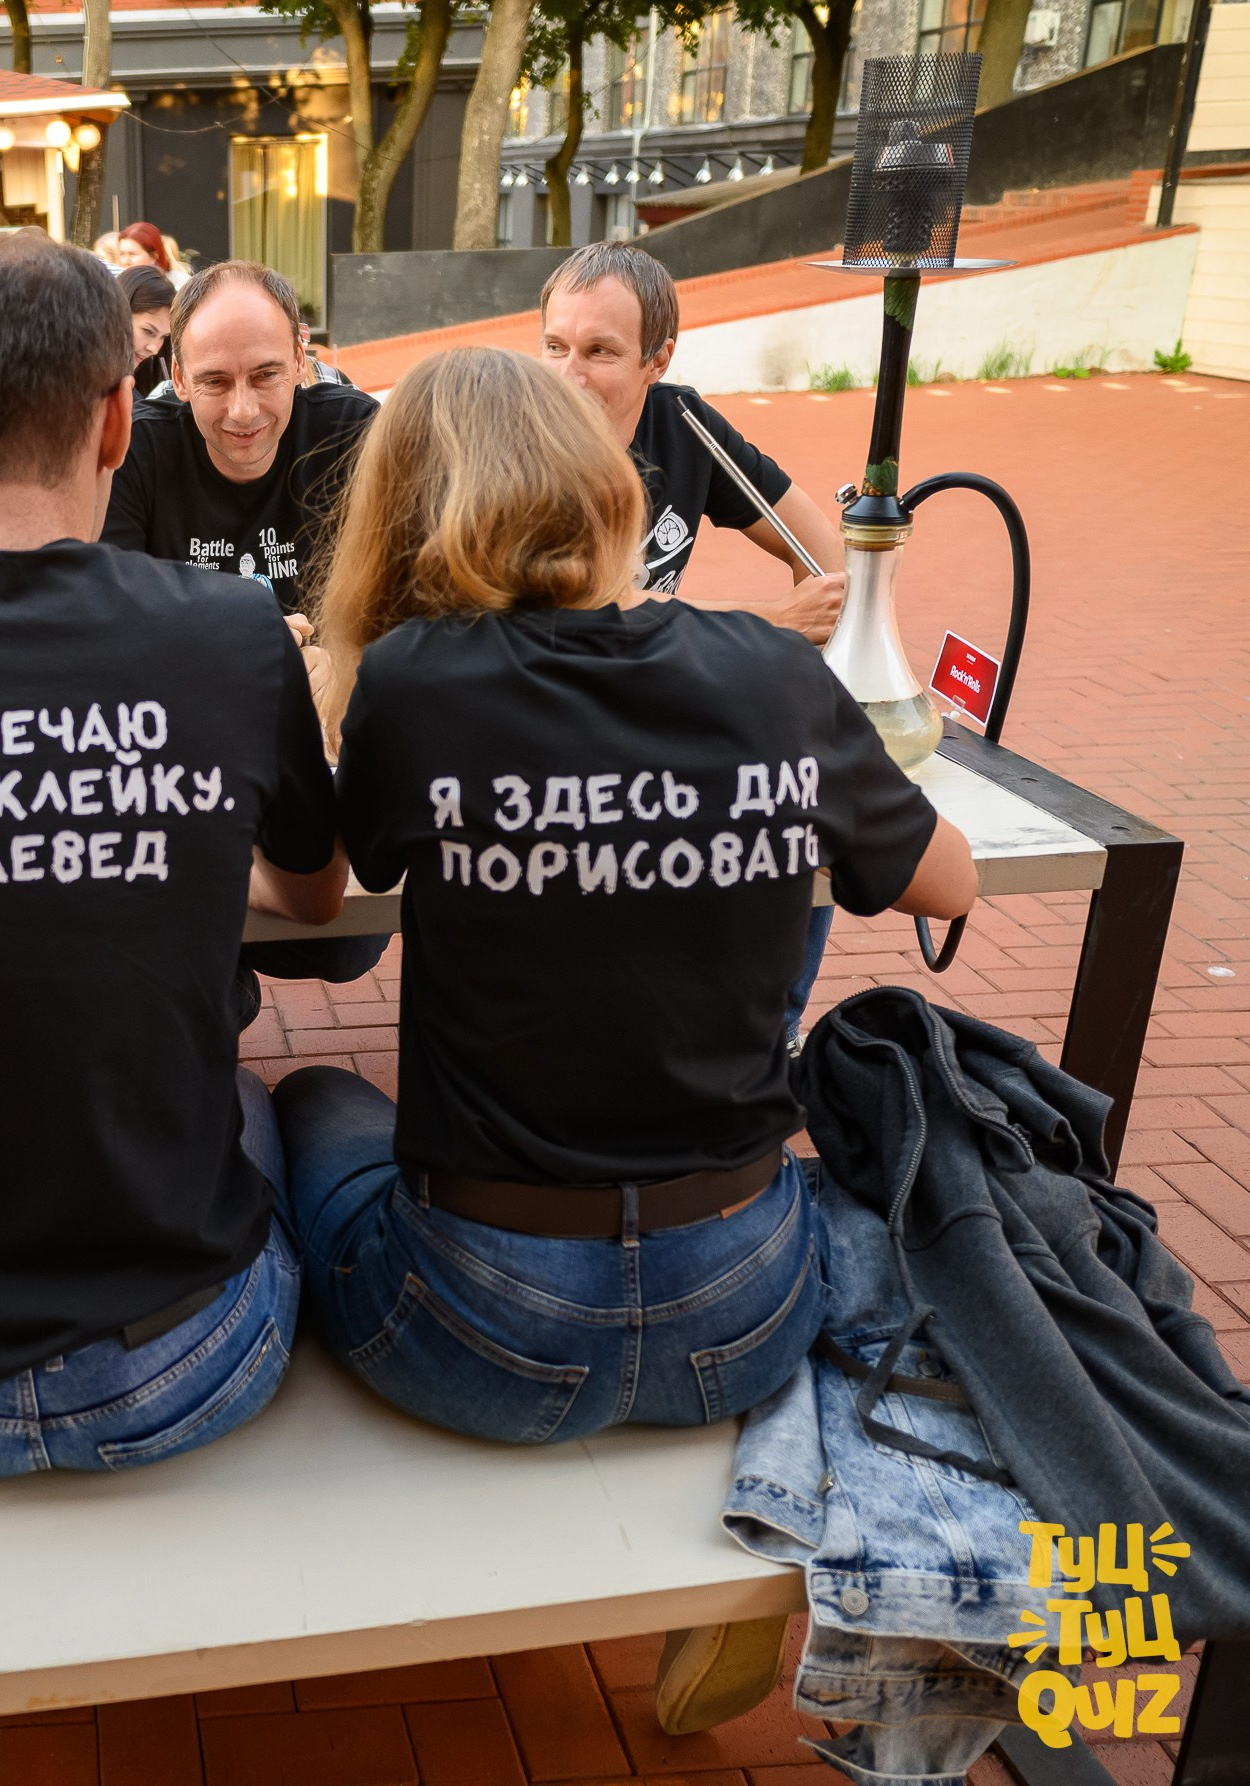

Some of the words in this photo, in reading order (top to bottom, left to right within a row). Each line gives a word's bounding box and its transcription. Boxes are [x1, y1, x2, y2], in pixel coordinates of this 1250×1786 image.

[190, 537, 235, 557] Battle
[258, 527, 277, 548] 10
[197, 554, 209, 563] for
[264, 541, 296, 559] points
[269, 554, 281, 562] for
[267, 558, 299, 580] JINR
[429, 776, 464, 829] Я
[492, 770, 699, 832] ЗДЕСЬ
[729, 756, 819, 820] ДЛЯ
[440, 824, 820, 896] ПОРИСОВАТЬ
